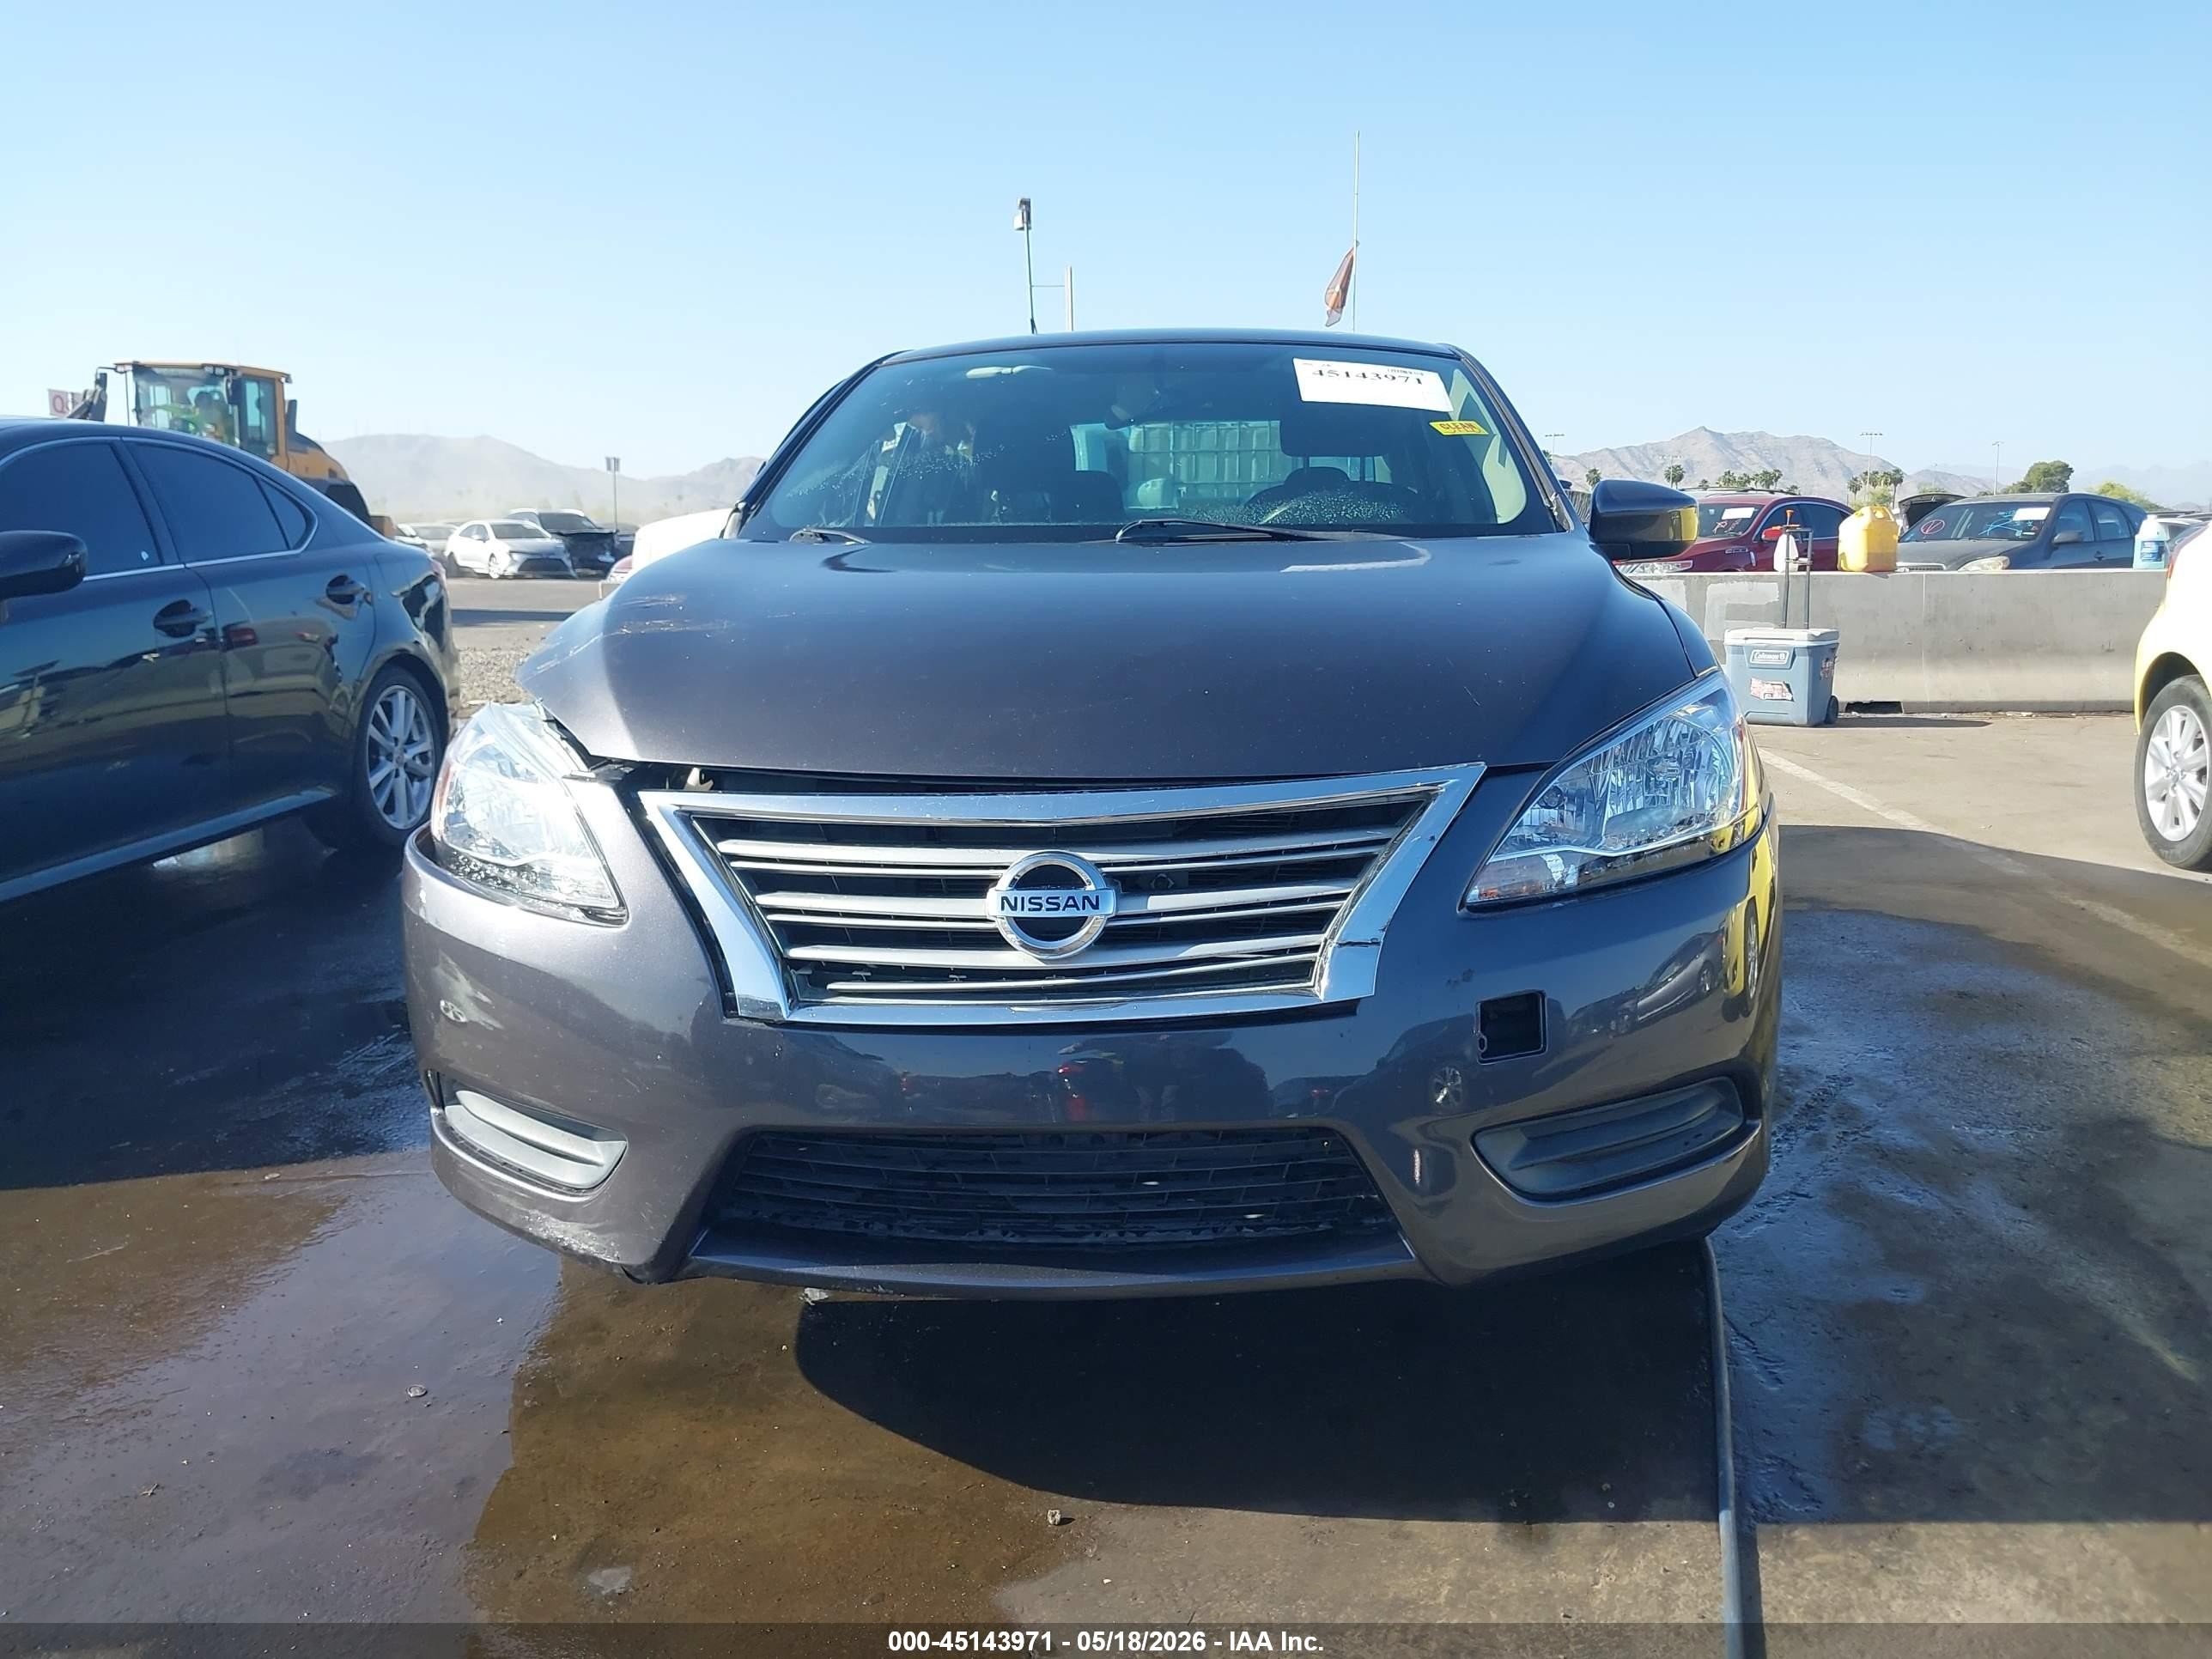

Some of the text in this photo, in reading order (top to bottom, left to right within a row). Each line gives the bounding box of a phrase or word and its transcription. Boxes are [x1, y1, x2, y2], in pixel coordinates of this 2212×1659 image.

[1312, 369, 1423, 385] 45143971
[1753, 652, 1779, 660] Coleman
[1000, 895, 1100, 912] NISSAN
